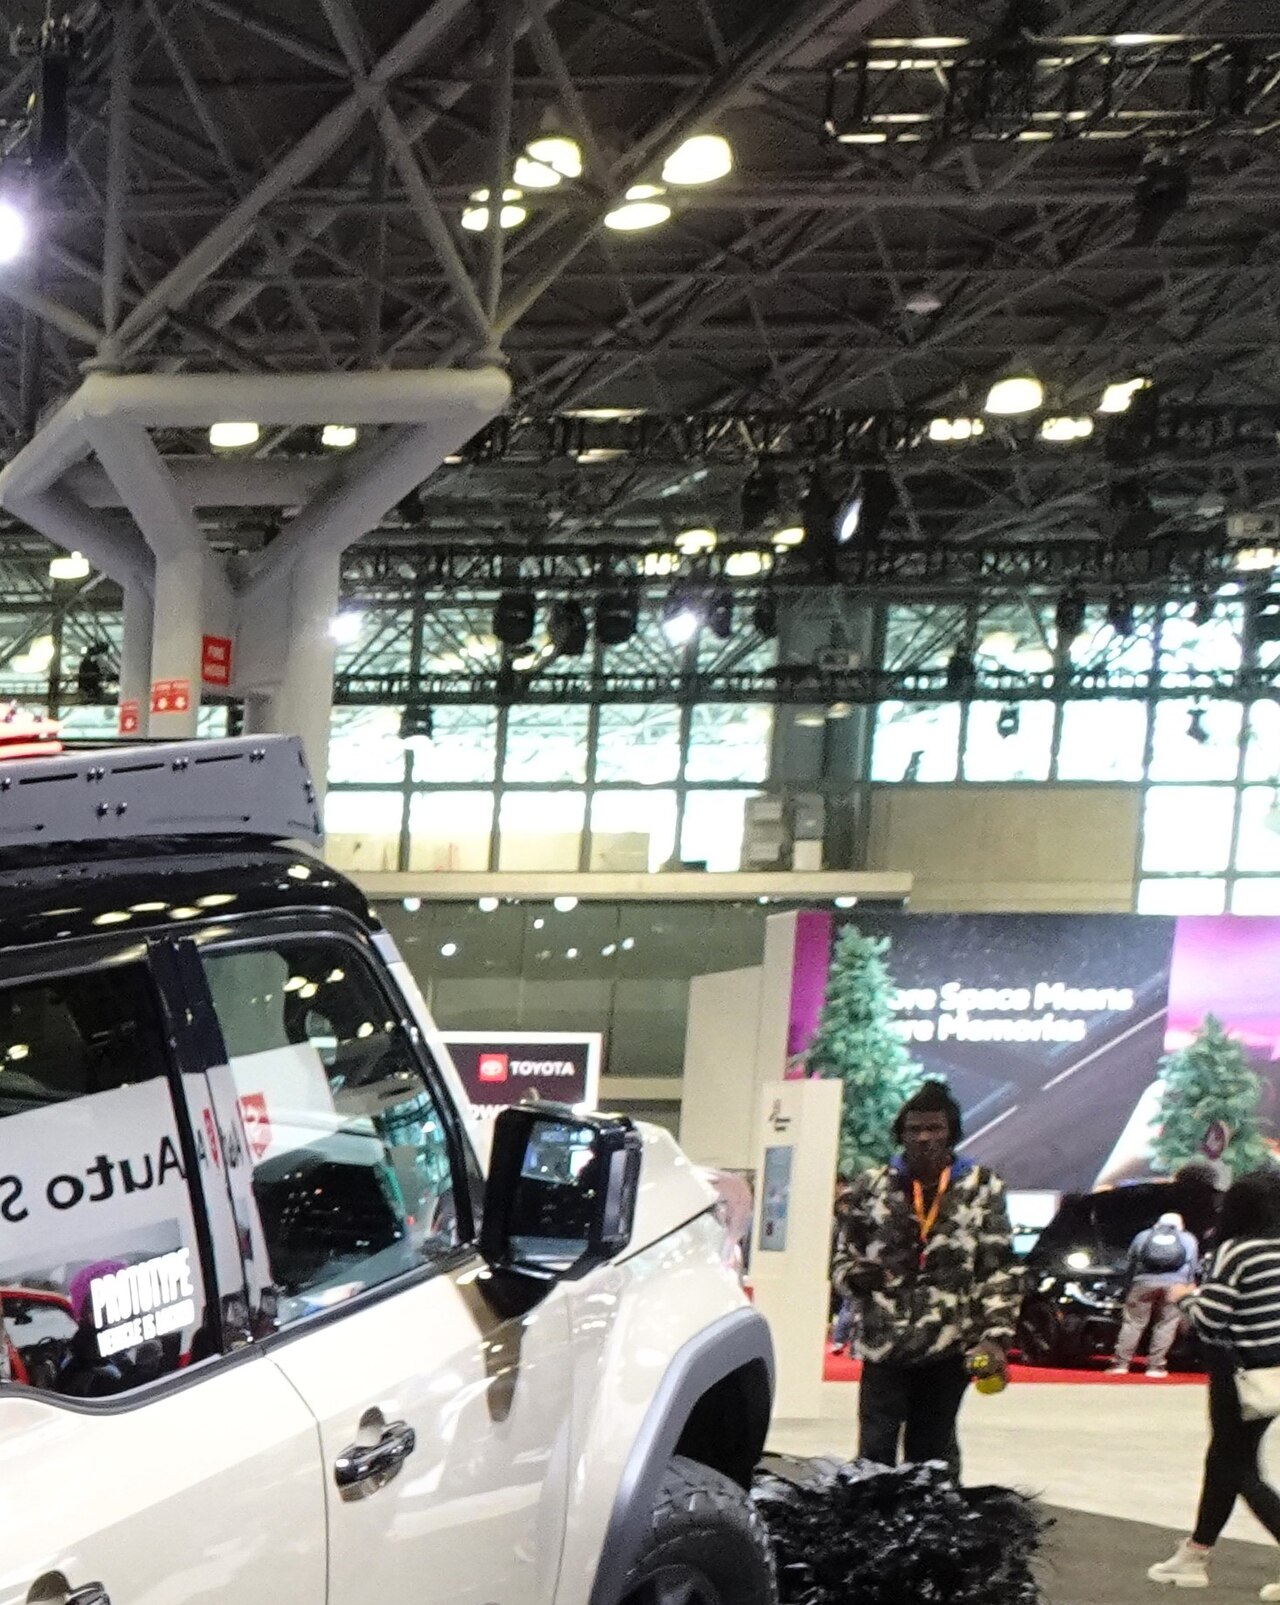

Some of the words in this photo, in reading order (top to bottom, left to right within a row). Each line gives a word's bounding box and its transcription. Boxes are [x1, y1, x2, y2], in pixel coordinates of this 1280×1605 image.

[887, 987, 937, 1011] ore
[940, 981, 1031, 1020] Space
[1033, 981, 1135, 1012] Means
[938, 1013, 1087, 1042] Memories
[510, 1060, 575, 1076] TOYOTA
